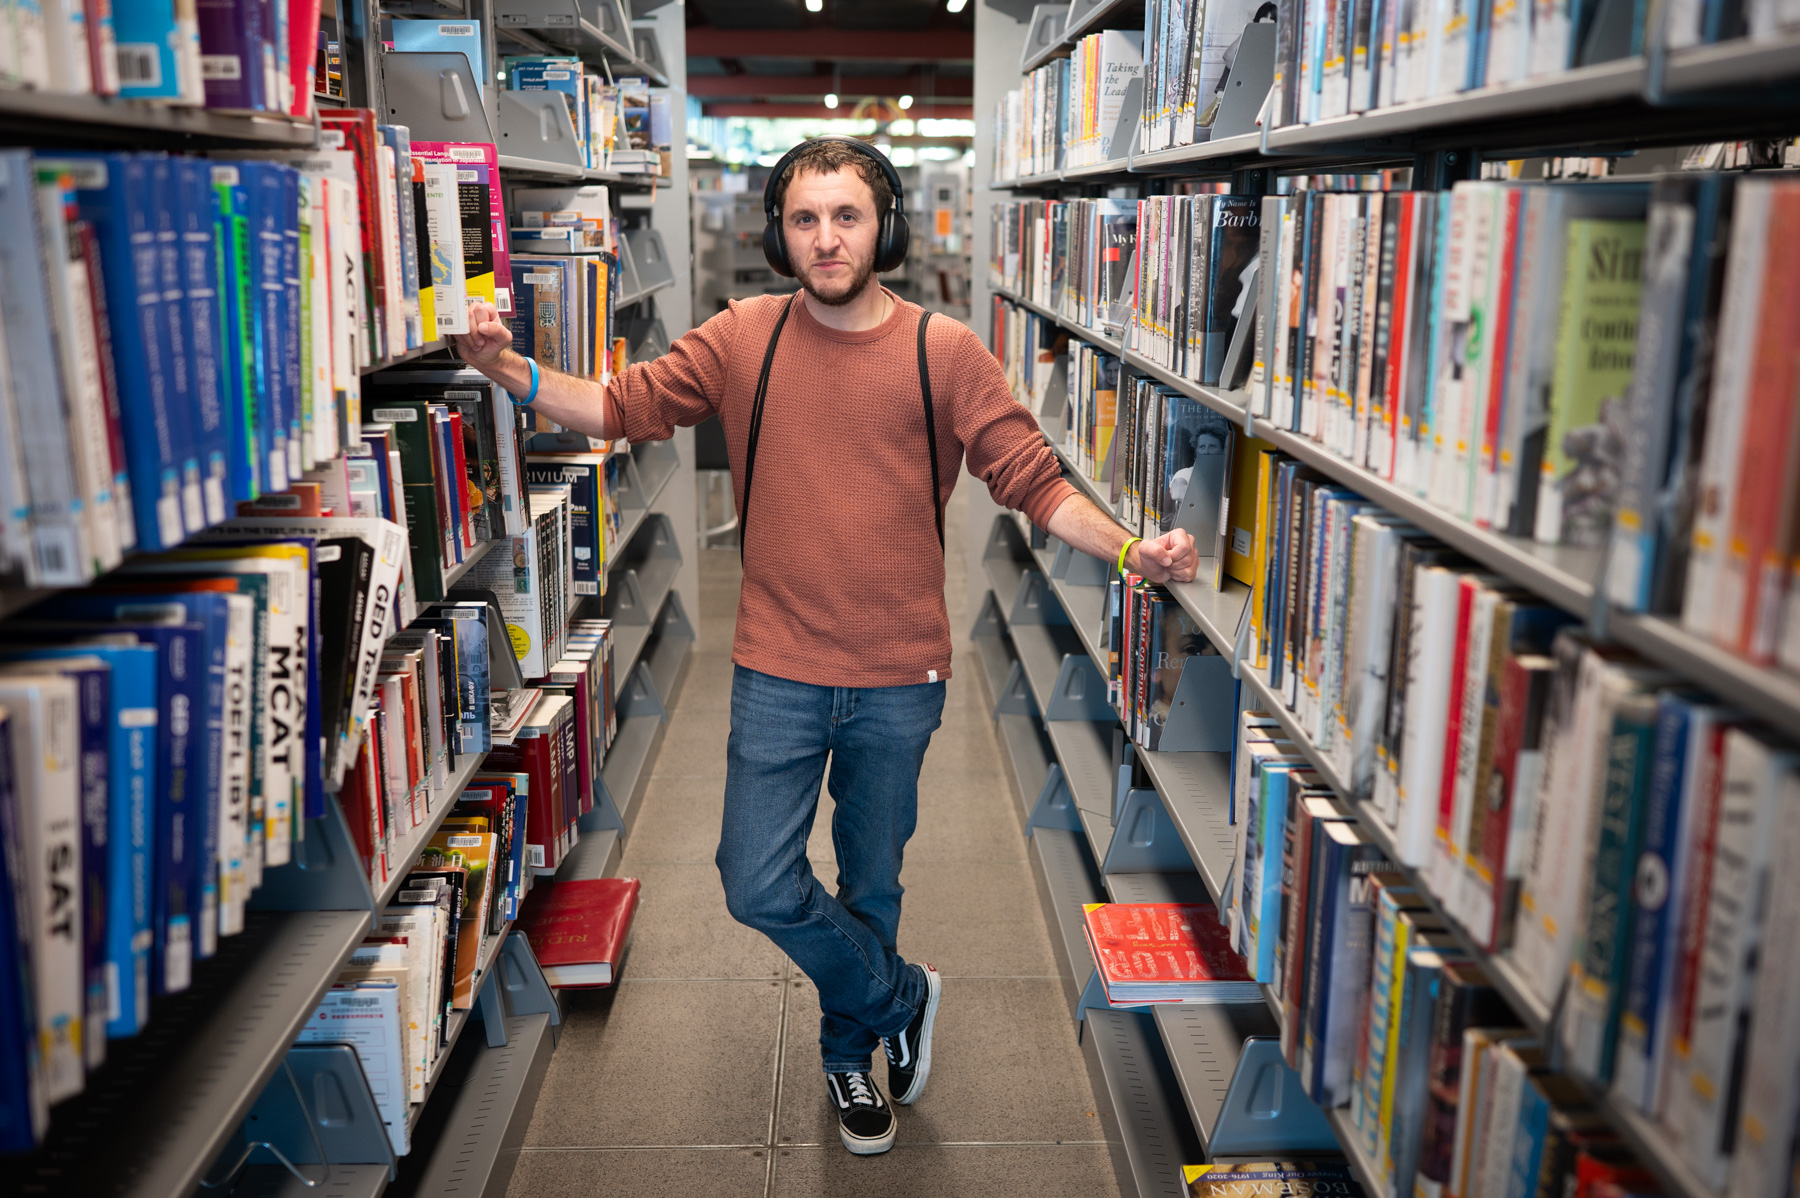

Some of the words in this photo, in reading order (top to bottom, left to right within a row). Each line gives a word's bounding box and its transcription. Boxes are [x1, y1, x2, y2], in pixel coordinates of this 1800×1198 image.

[1105, 74, 1119, 84] the
[1106, 62, 1140, 76] Taking
[1104, 86, 1128, 96] Lead
[1113, 234, 1127, 246] My
[1354, 217, 1365, 282] ROBERT
[1259, 249, 1269, 295] Pieces
[344, 252, 356, 327] ACT
[1255, 314, 1265, 342] Sally
[1351, 286, 1361, 336] SHAW
[1180, 404, 1202, 413] THE
[1293, 494, 1303, 528] DARK
[1289, 531, 1300, 615] RENAISSANCE
[370, 583, 389, 639] GED
[1140, 599, 1148, 642] CHAIM
[359, 645, 378, 700] Test
[1137, 645, 1145, 703] SOUTINE
[269, 645, 293, 773] MCAT
[468, 681, 476, 704] ШКАФУ
[230, 662, 245, 767] TOEFL
[565, 722, 575, 759] LMP
[46, 841, 75, 943] SAT
[547, 934, 588, 945] RED
[1096, 907, 1231, 940] SWIFT
[1106, 949, 1230, 979] AYLOR
[1209, 1181, 1351, 1195] BOSEMAN
[1262, 1171, 1285, 1179] King
[1306, 1170, 1344, 1179] Forever
